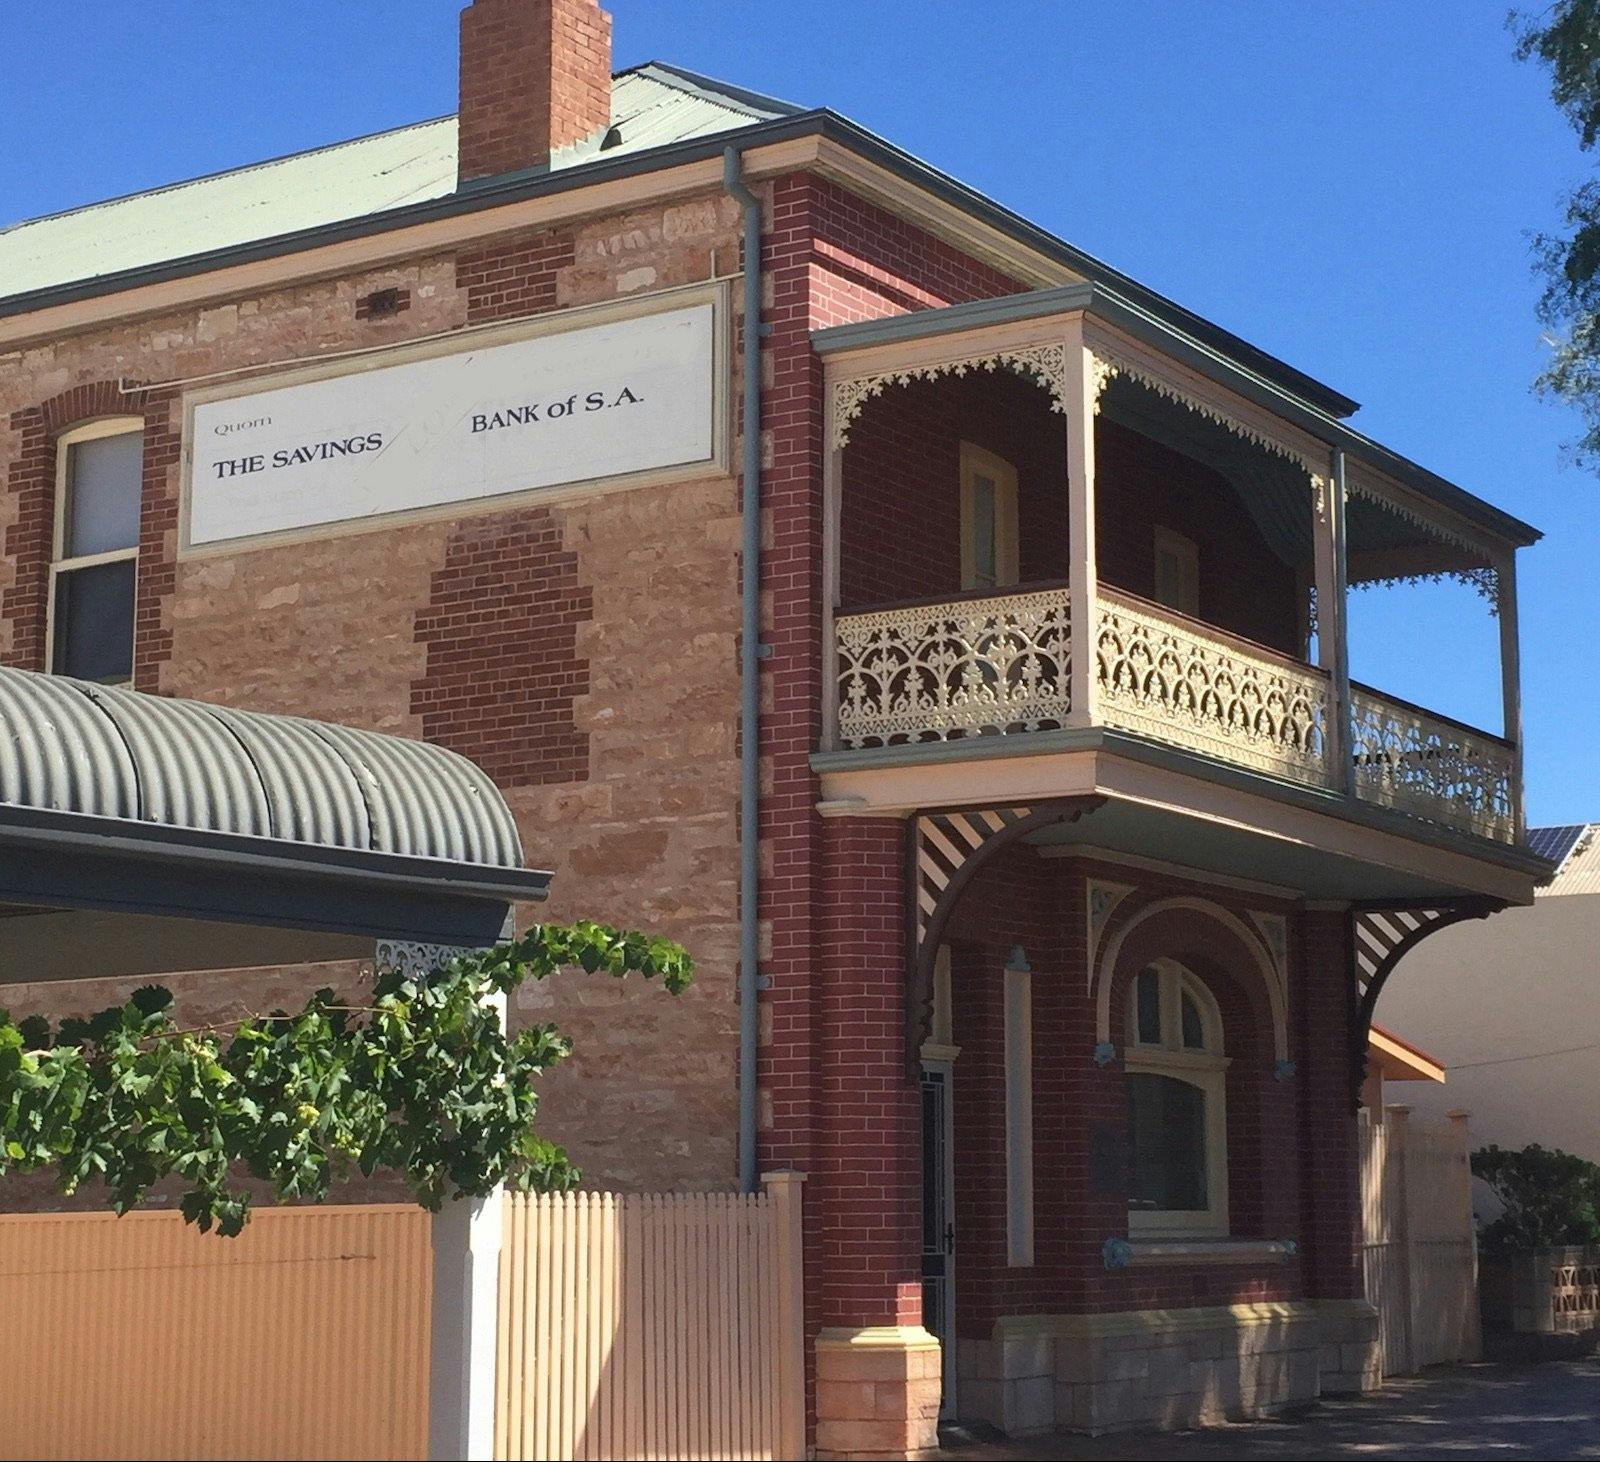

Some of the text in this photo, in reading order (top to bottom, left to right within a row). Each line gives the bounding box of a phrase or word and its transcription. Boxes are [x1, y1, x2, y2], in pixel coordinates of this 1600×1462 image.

[212, 387, 645, 479] THE SAVINGS BANK of S.A.
